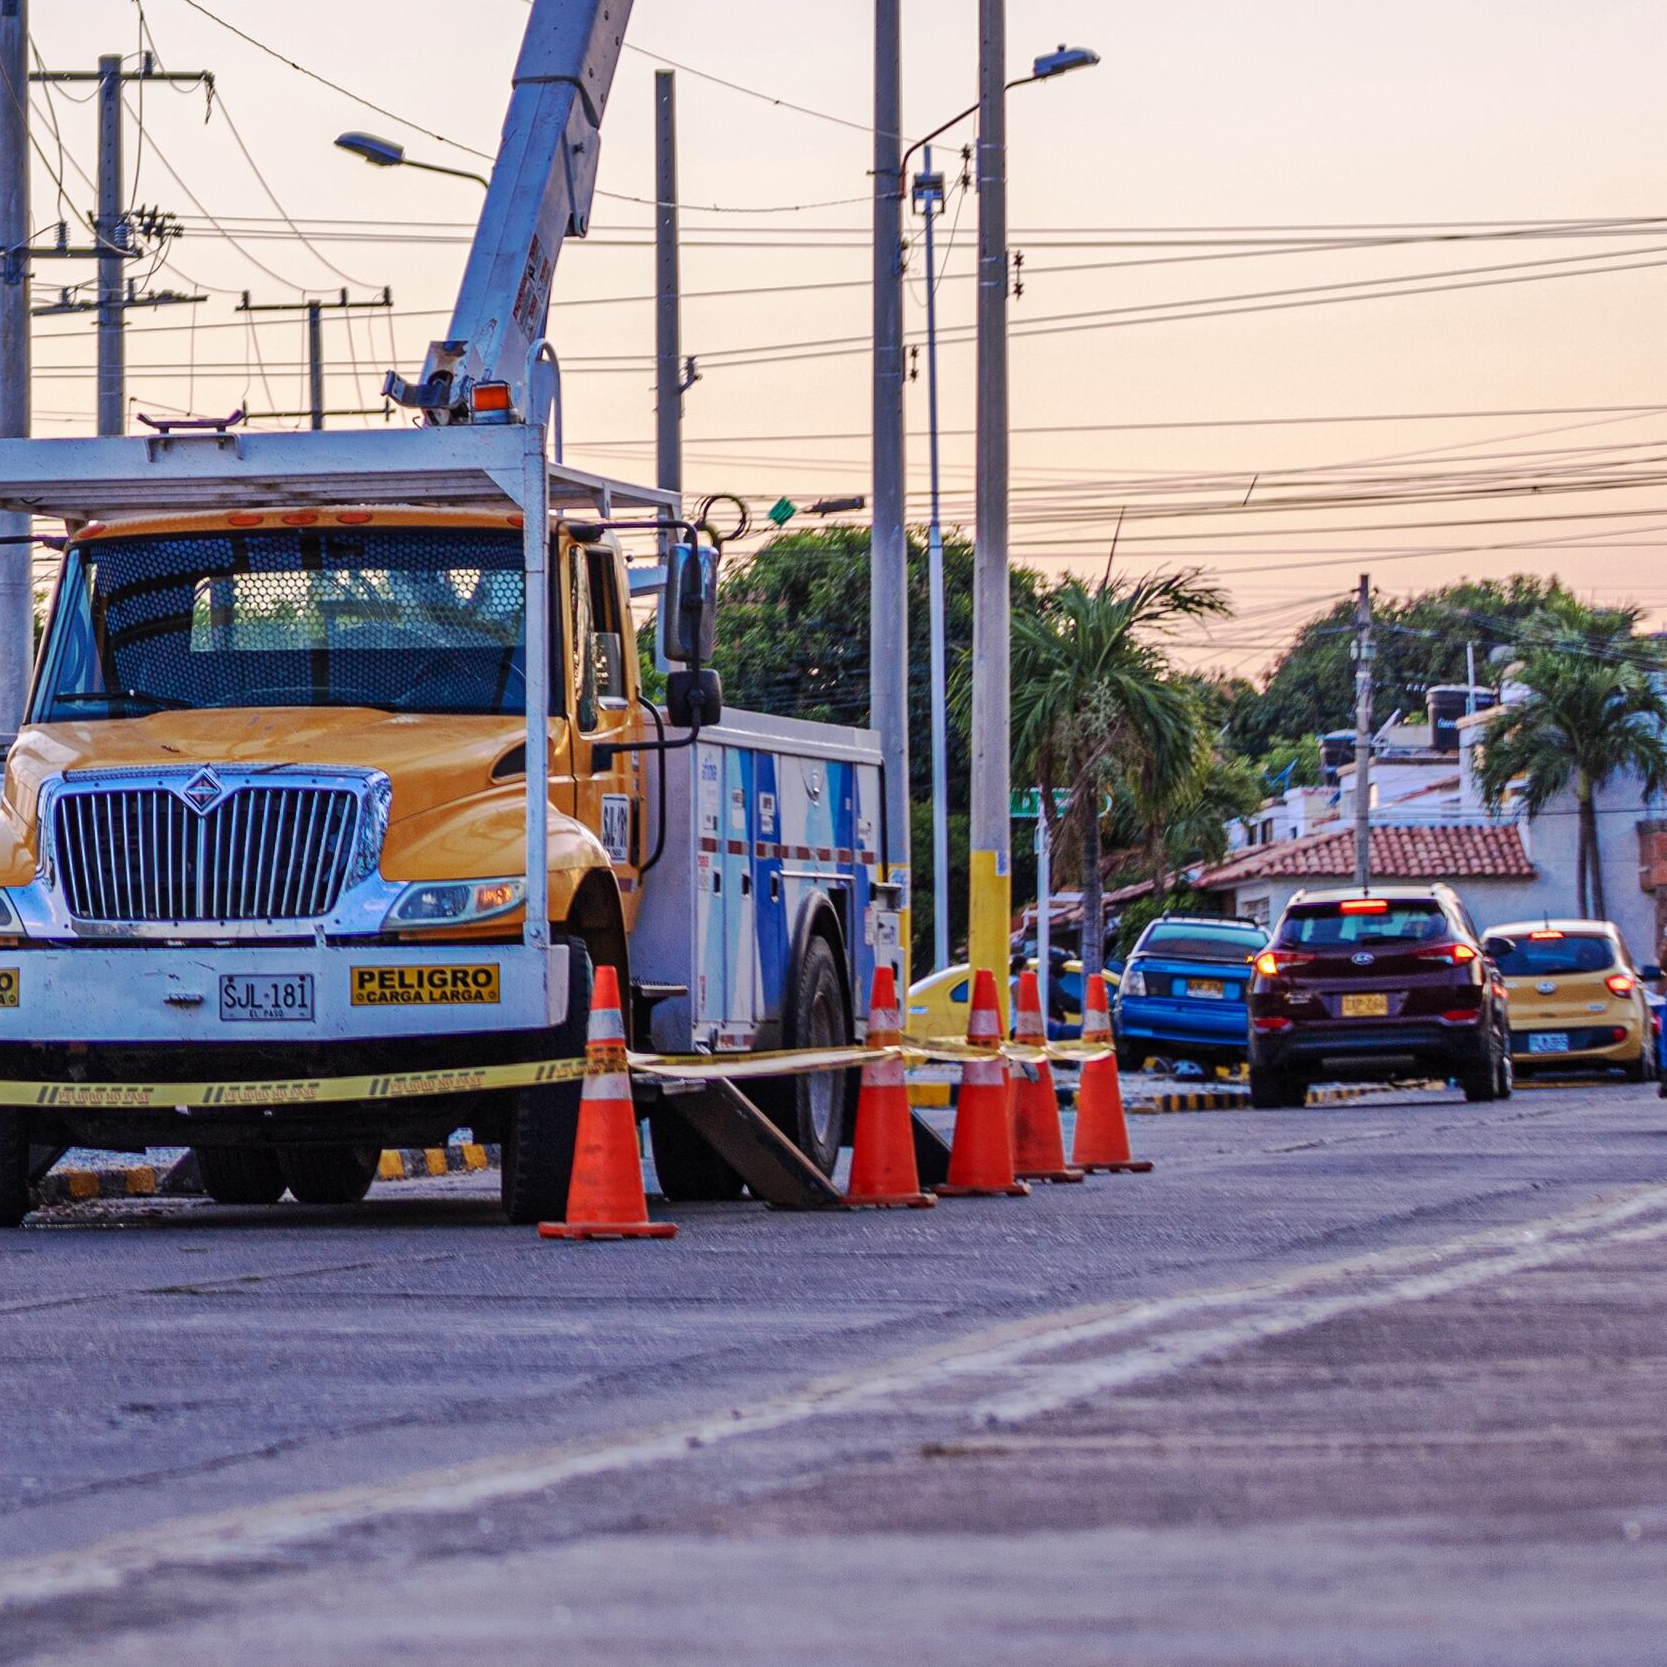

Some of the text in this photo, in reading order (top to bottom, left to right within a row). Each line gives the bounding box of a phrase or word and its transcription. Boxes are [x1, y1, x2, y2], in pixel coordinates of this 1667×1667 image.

[357, 967, 493, 990] PELIGRO
[367, 989, 485, 1003] CARGA LARGA
[263, 1010, 285, 1018] PASO
[106, 1091, 121, 1103] NO
